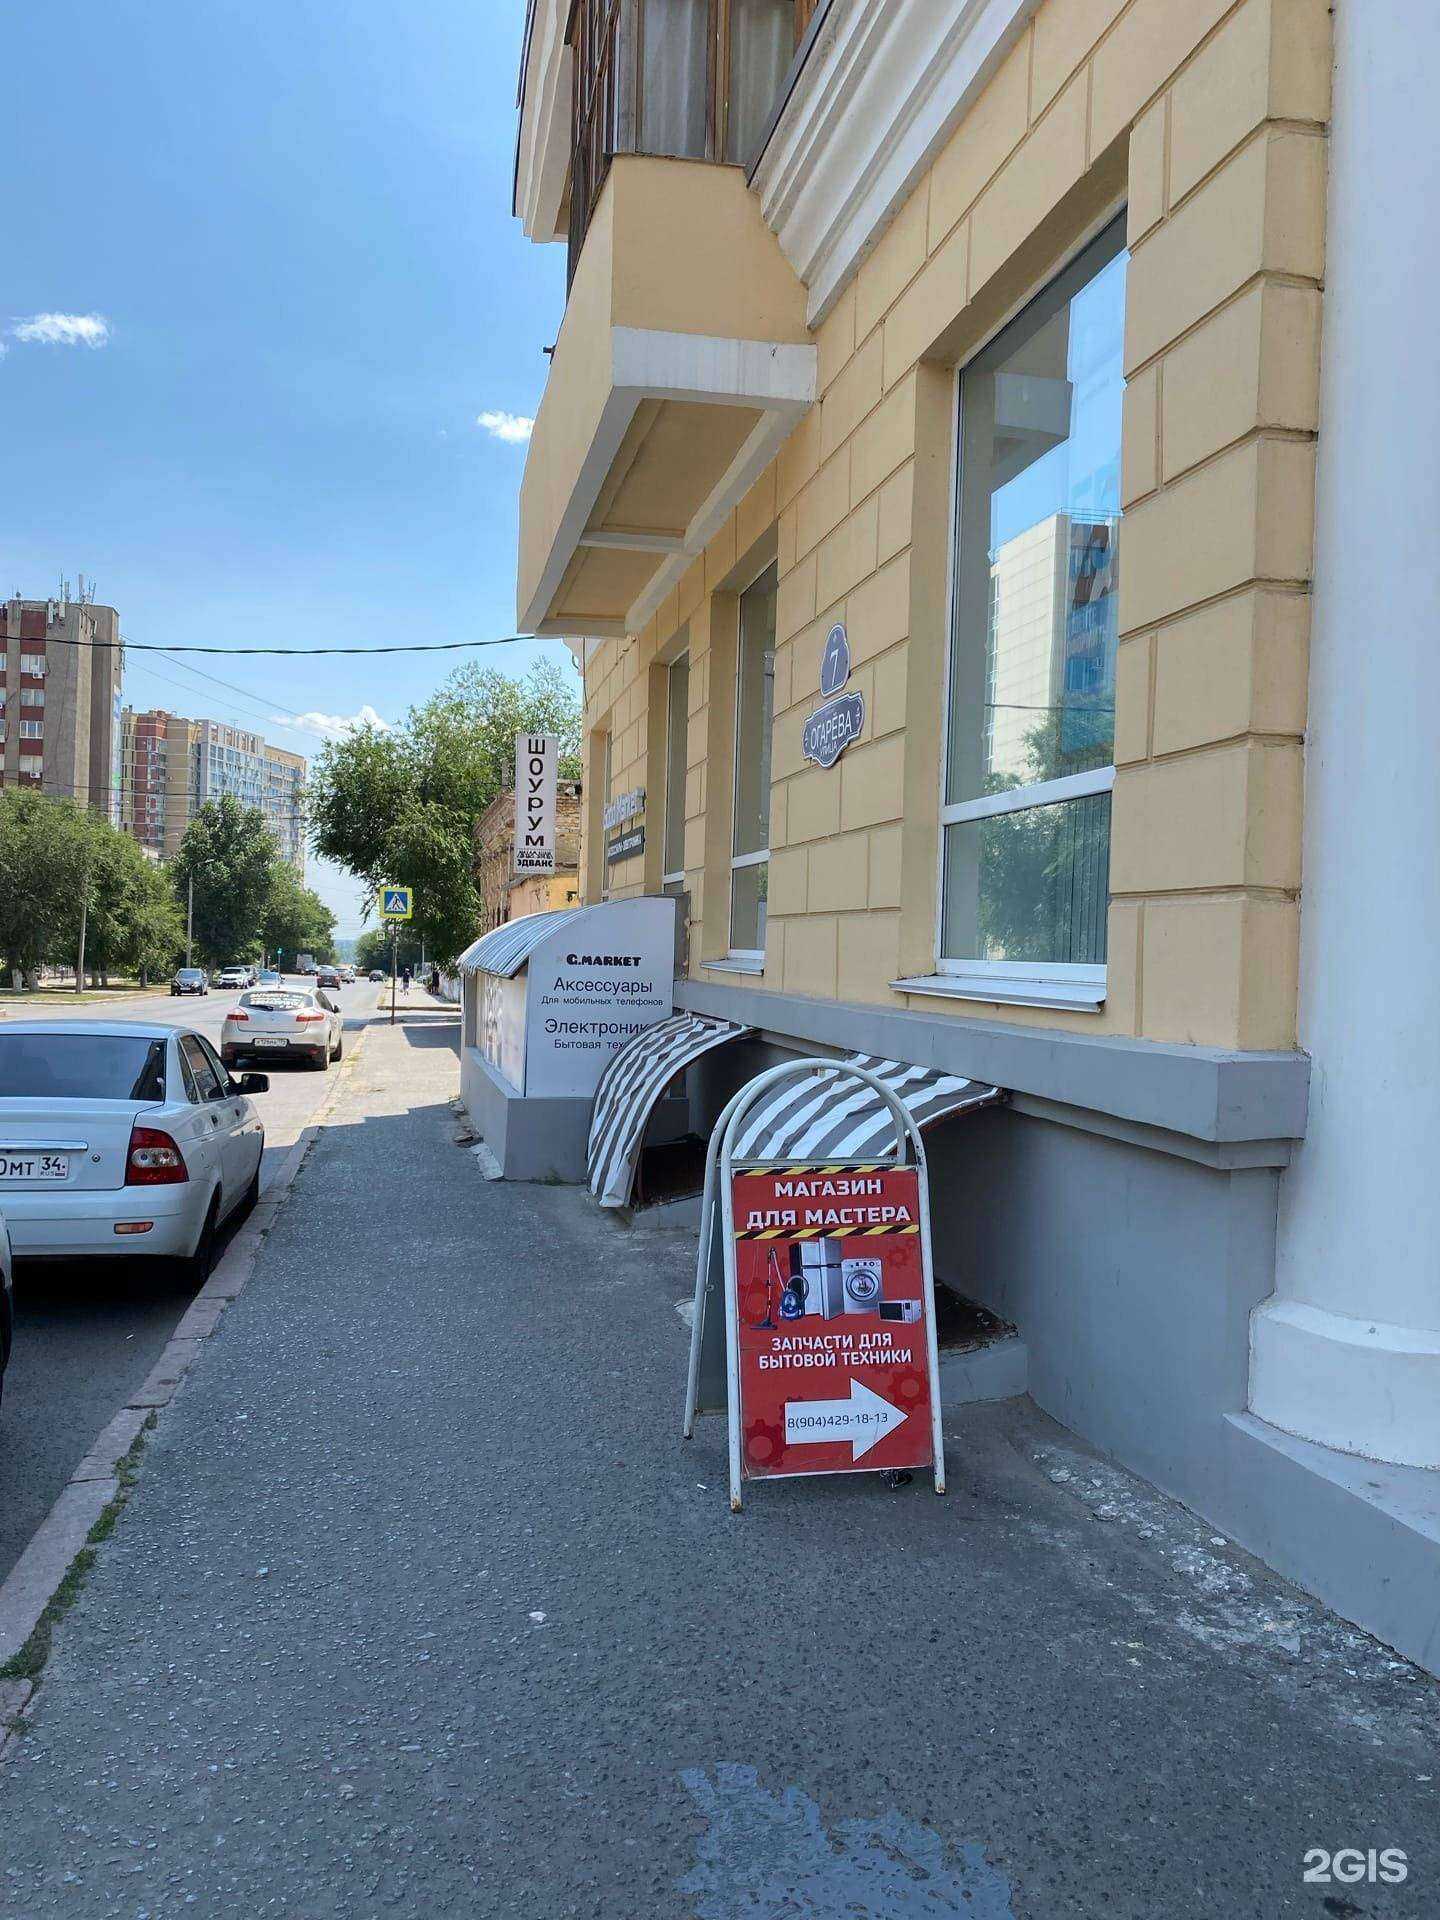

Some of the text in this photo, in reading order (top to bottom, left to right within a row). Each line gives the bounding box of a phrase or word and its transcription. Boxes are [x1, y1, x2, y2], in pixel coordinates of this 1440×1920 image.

[829, 648, 839, 686] 7
[525, 738, 546, 847] ШОУРУМ
[517, 858, 553, 868] ЭДВАНС
[553, 977, 653, 995] Аксессуары
[541, 996, 664, 1008] Для мобильных телефонов
[545, 1018, 650, 1037] Электроник
[554, 1039, 601, 1049] Бытовая
[41, 1156, 60, 1171] 34
[774, 1179, 882, 1198] МАГАЗИН
[746, 1206, 911, 1230] ДЛЯ МАСТЕРА
[771, 1332, 893, 1351] ЗАПЧАСТИ ДЛЯ
[758, 1349, 912, 1370] БЫТОВОЙ ТЕХНИКИ
[787, 1412, 889, 1429] 8(904)429-18-13
